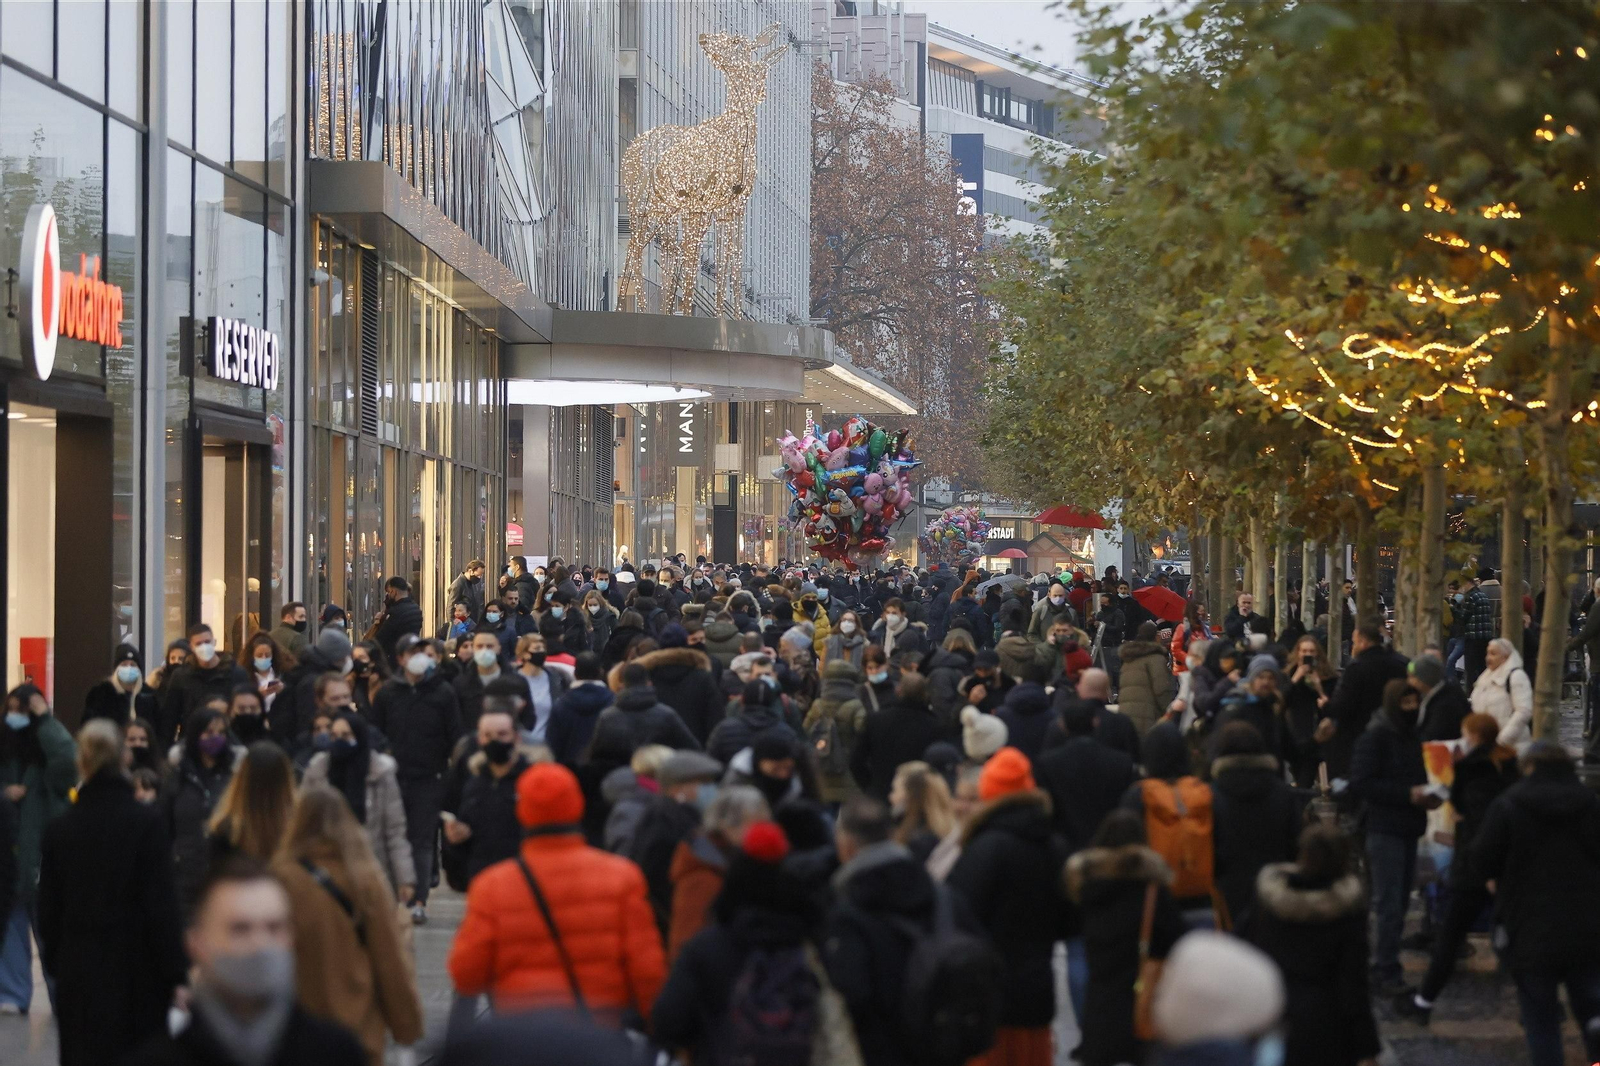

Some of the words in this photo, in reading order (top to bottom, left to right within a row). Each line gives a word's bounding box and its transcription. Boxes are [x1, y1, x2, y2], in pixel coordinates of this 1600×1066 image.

[59, 252, 123, 349] vodafone
[215, 316, 280, 391] RESERVED
[679, 403, 694, 453] MAN
